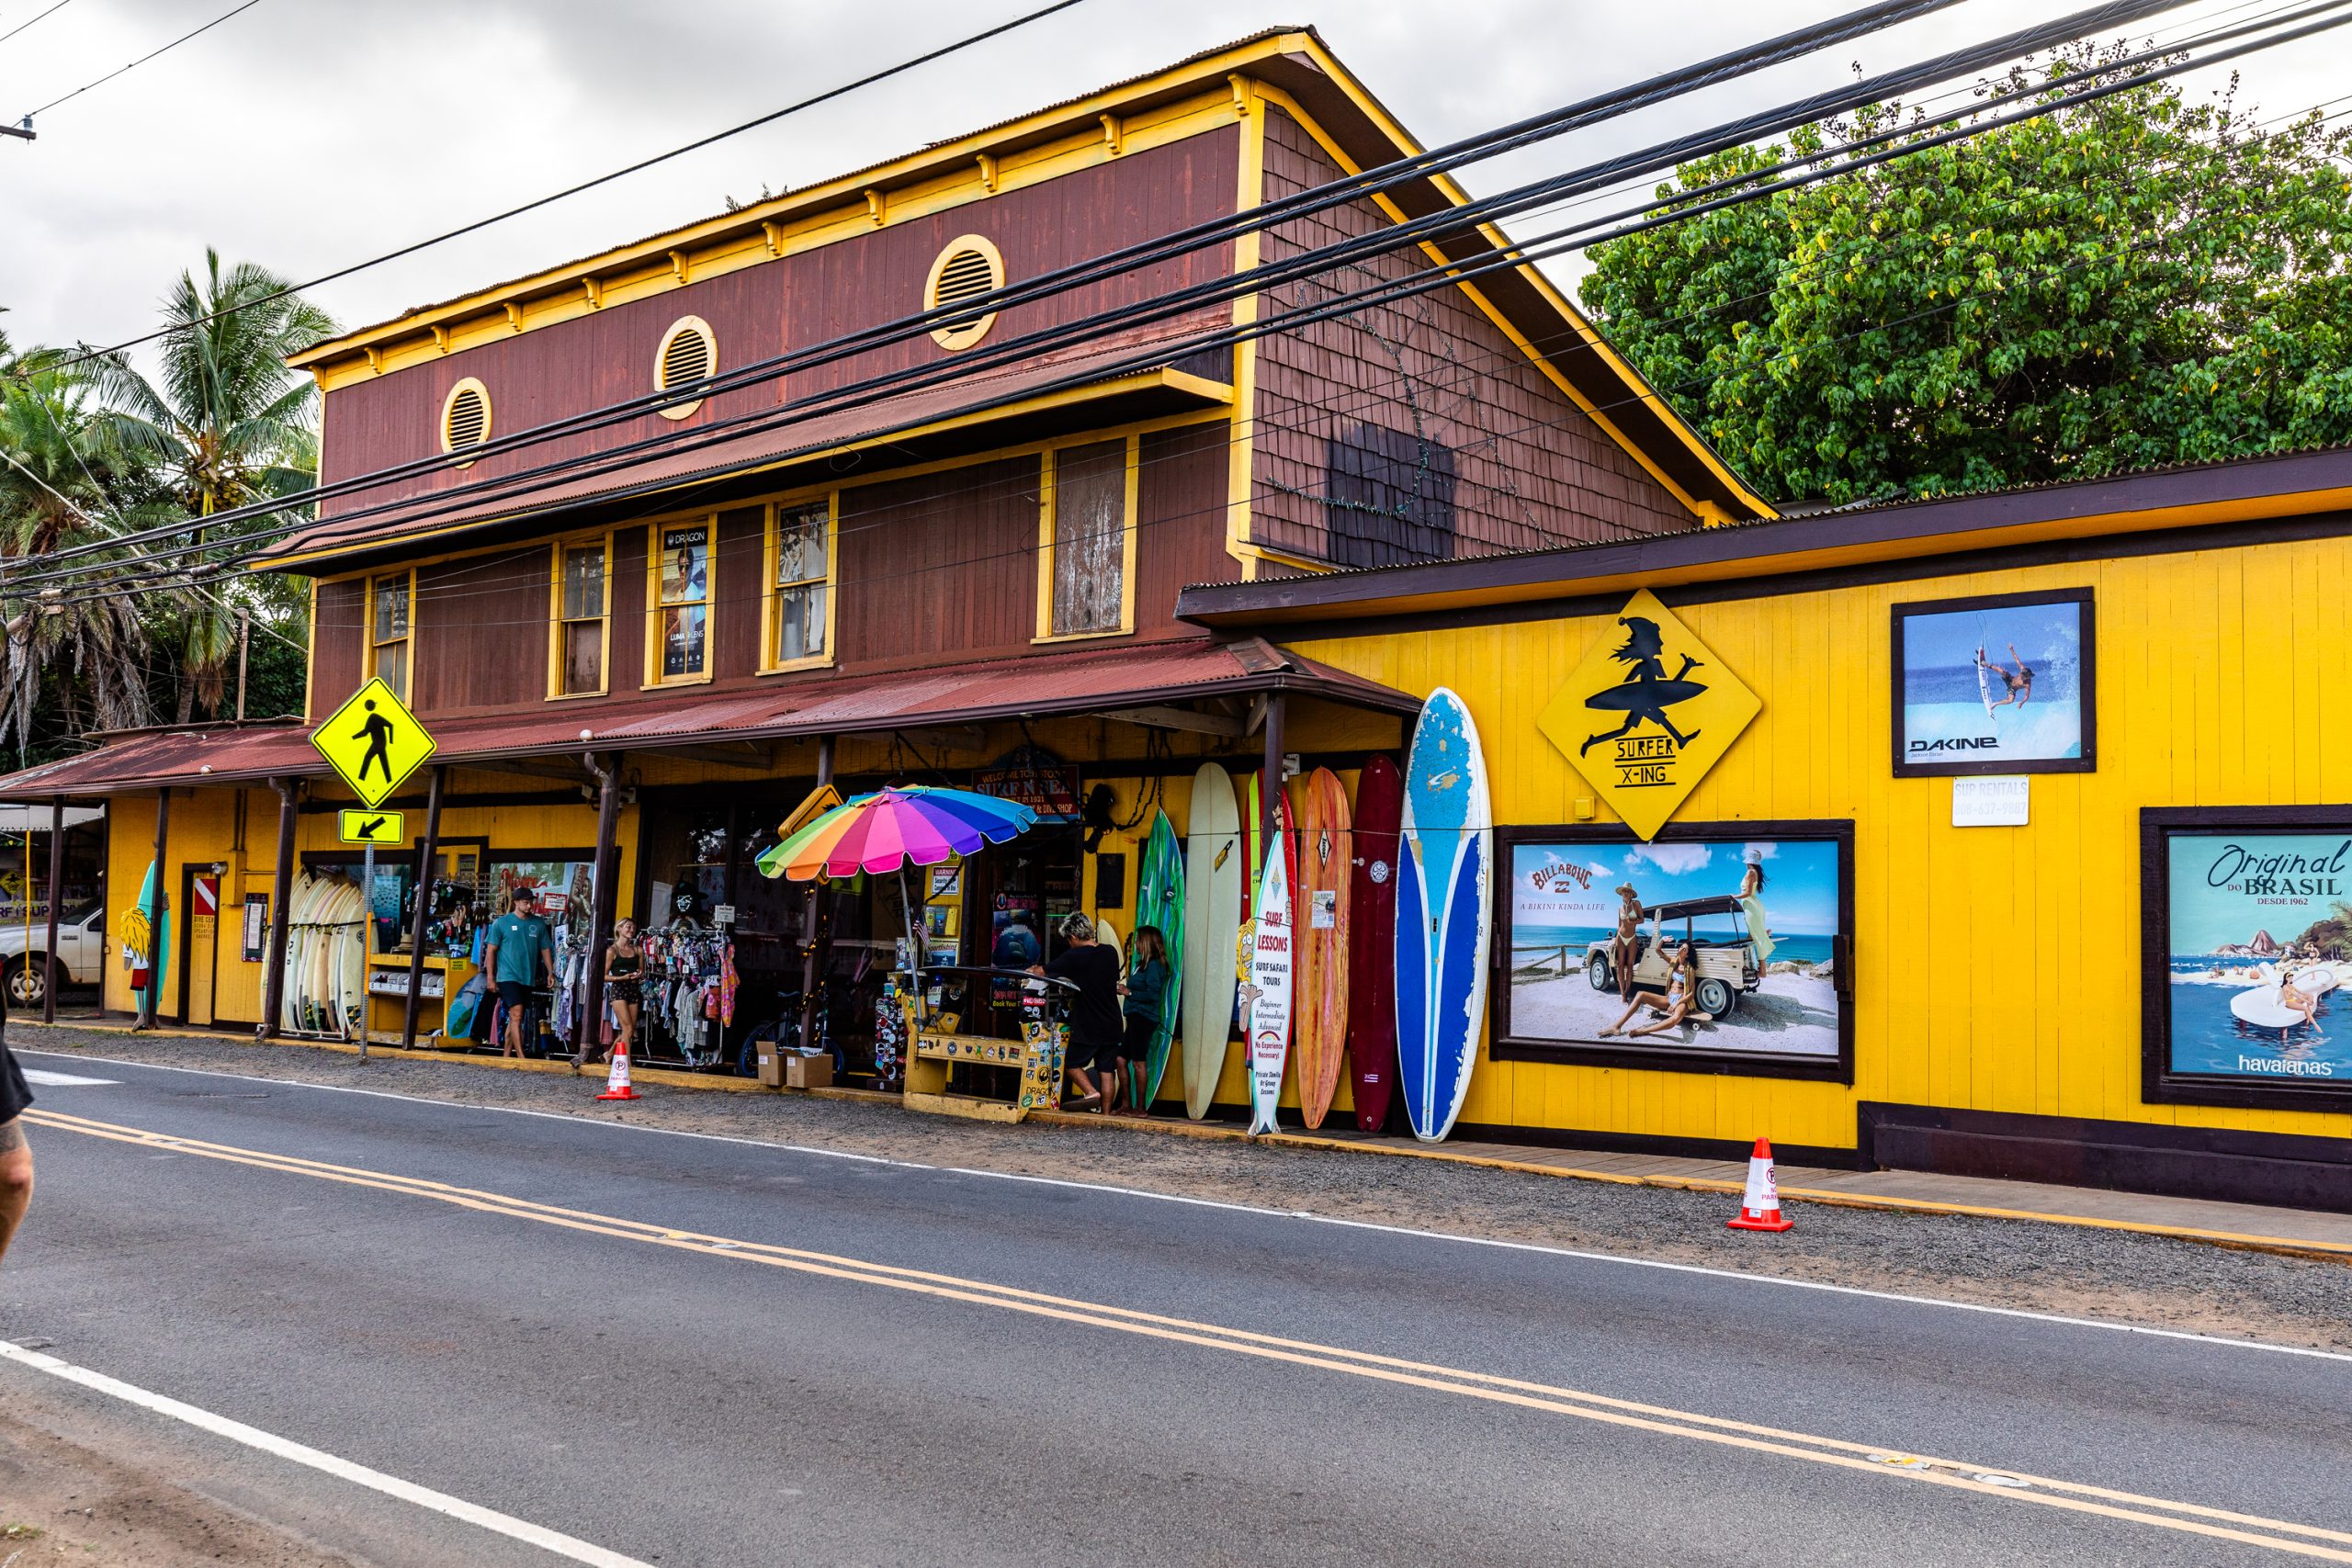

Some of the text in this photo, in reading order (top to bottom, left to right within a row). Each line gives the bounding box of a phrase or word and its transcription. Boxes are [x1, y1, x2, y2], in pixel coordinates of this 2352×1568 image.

[1618, 739, 1673, 757] SURFER
[1908, 737, 1999, 751] DAKINE
[1623, 766, 1666, 784] X-ING
[1955, 781, 2028, 797] SUP RENTALS
[1057, 803, 1073, 814] SHOP
[2208, 840, 2352, 887] Original
[1532, 863, 1593, 890] BILLABONG
[2244, 878, 2343, 896] BRASIL
[1265, 911, 1283, 928] SURF
[1257, 934, 1288, 953] LESSONS
[1256, 962, 1288, 973] SURF SAFARI
[1262, 976, 1281, 986] TOURS
[1260, 999, 1283, 1010] Beginner
[1255, 1010, 1286, 1020] Intermediate
[1261, 1042, 1283, 1050] Experience
[2238, 1055, 2333, 1076] havaianas
